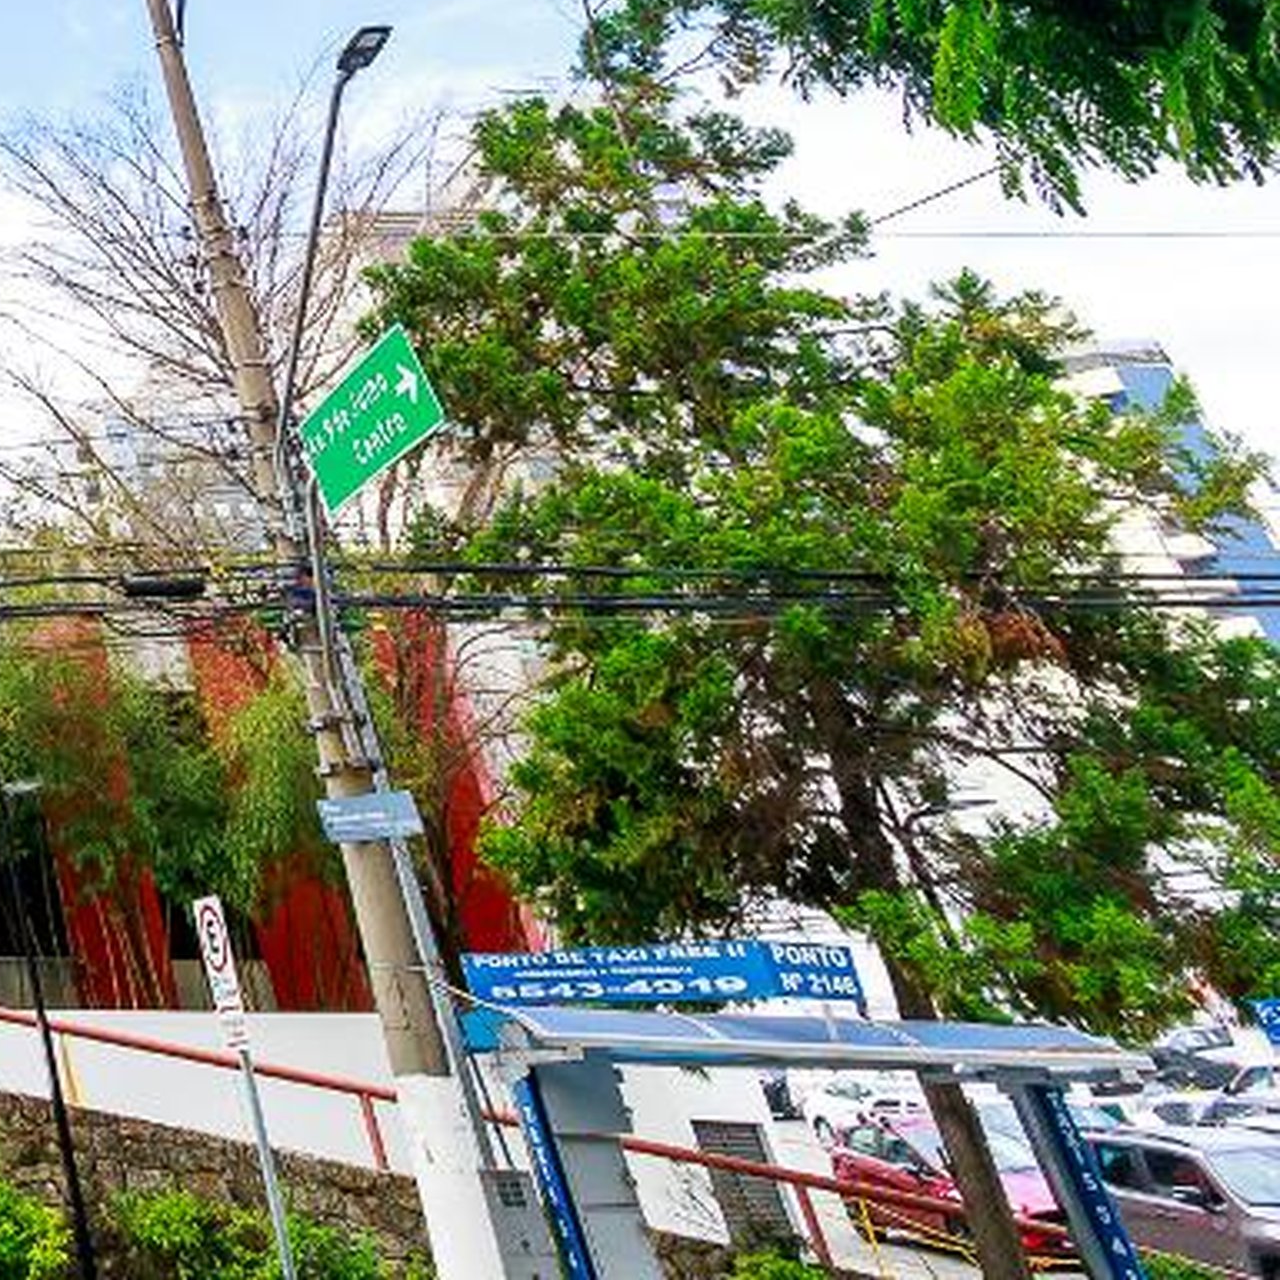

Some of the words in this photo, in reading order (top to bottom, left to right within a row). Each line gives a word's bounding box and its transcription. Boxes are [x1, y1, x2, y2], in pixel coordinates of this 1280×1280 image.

[352, 412, 407, 464] Centro
[591, 947, 648, 964] TAXI
[771, 944, 847, 968] PONTO
